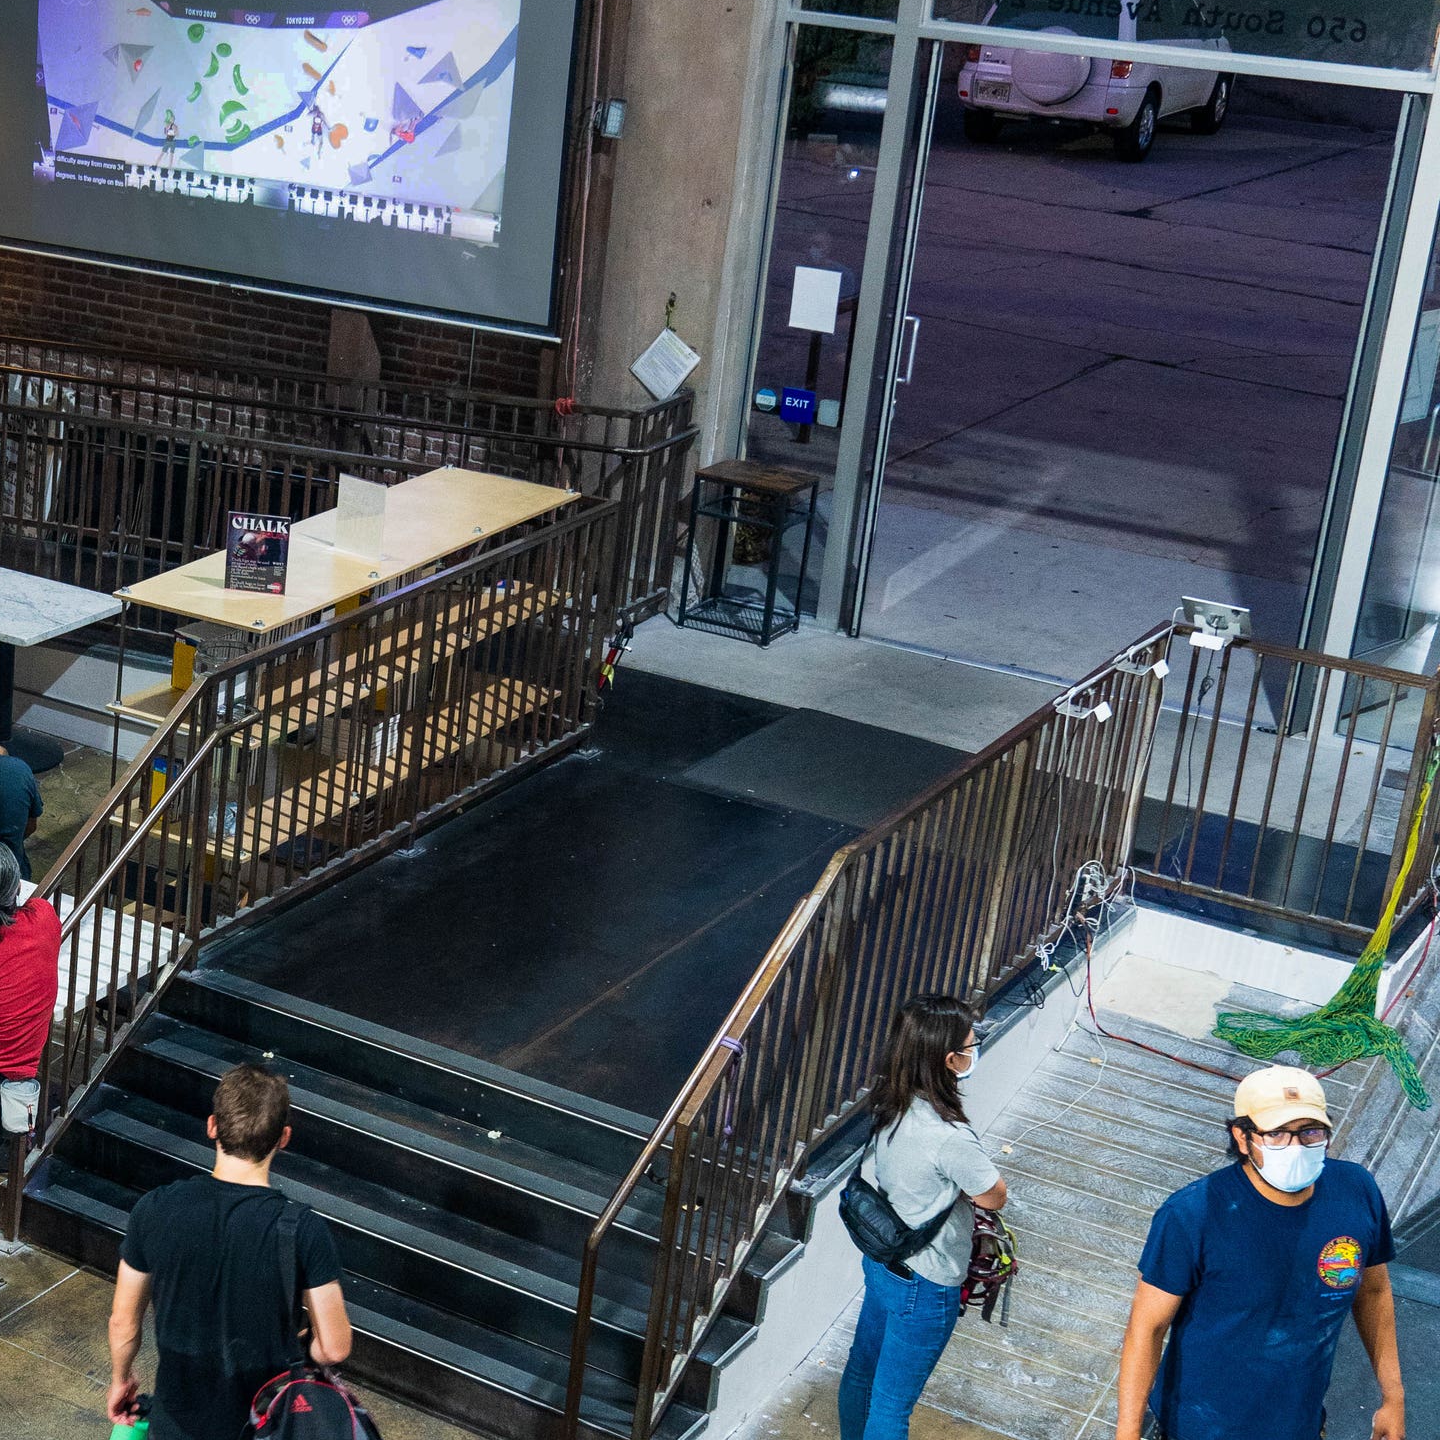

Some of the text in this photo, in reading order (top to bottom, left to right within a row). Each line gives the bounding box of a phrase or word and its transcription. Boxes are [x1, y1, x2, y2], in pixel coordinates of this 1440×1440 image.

[185, 8, 216, 18] TOKYO 2020
[785, 397, 810, 409] EXIT
[232, 517, 289, 534] CHALK
